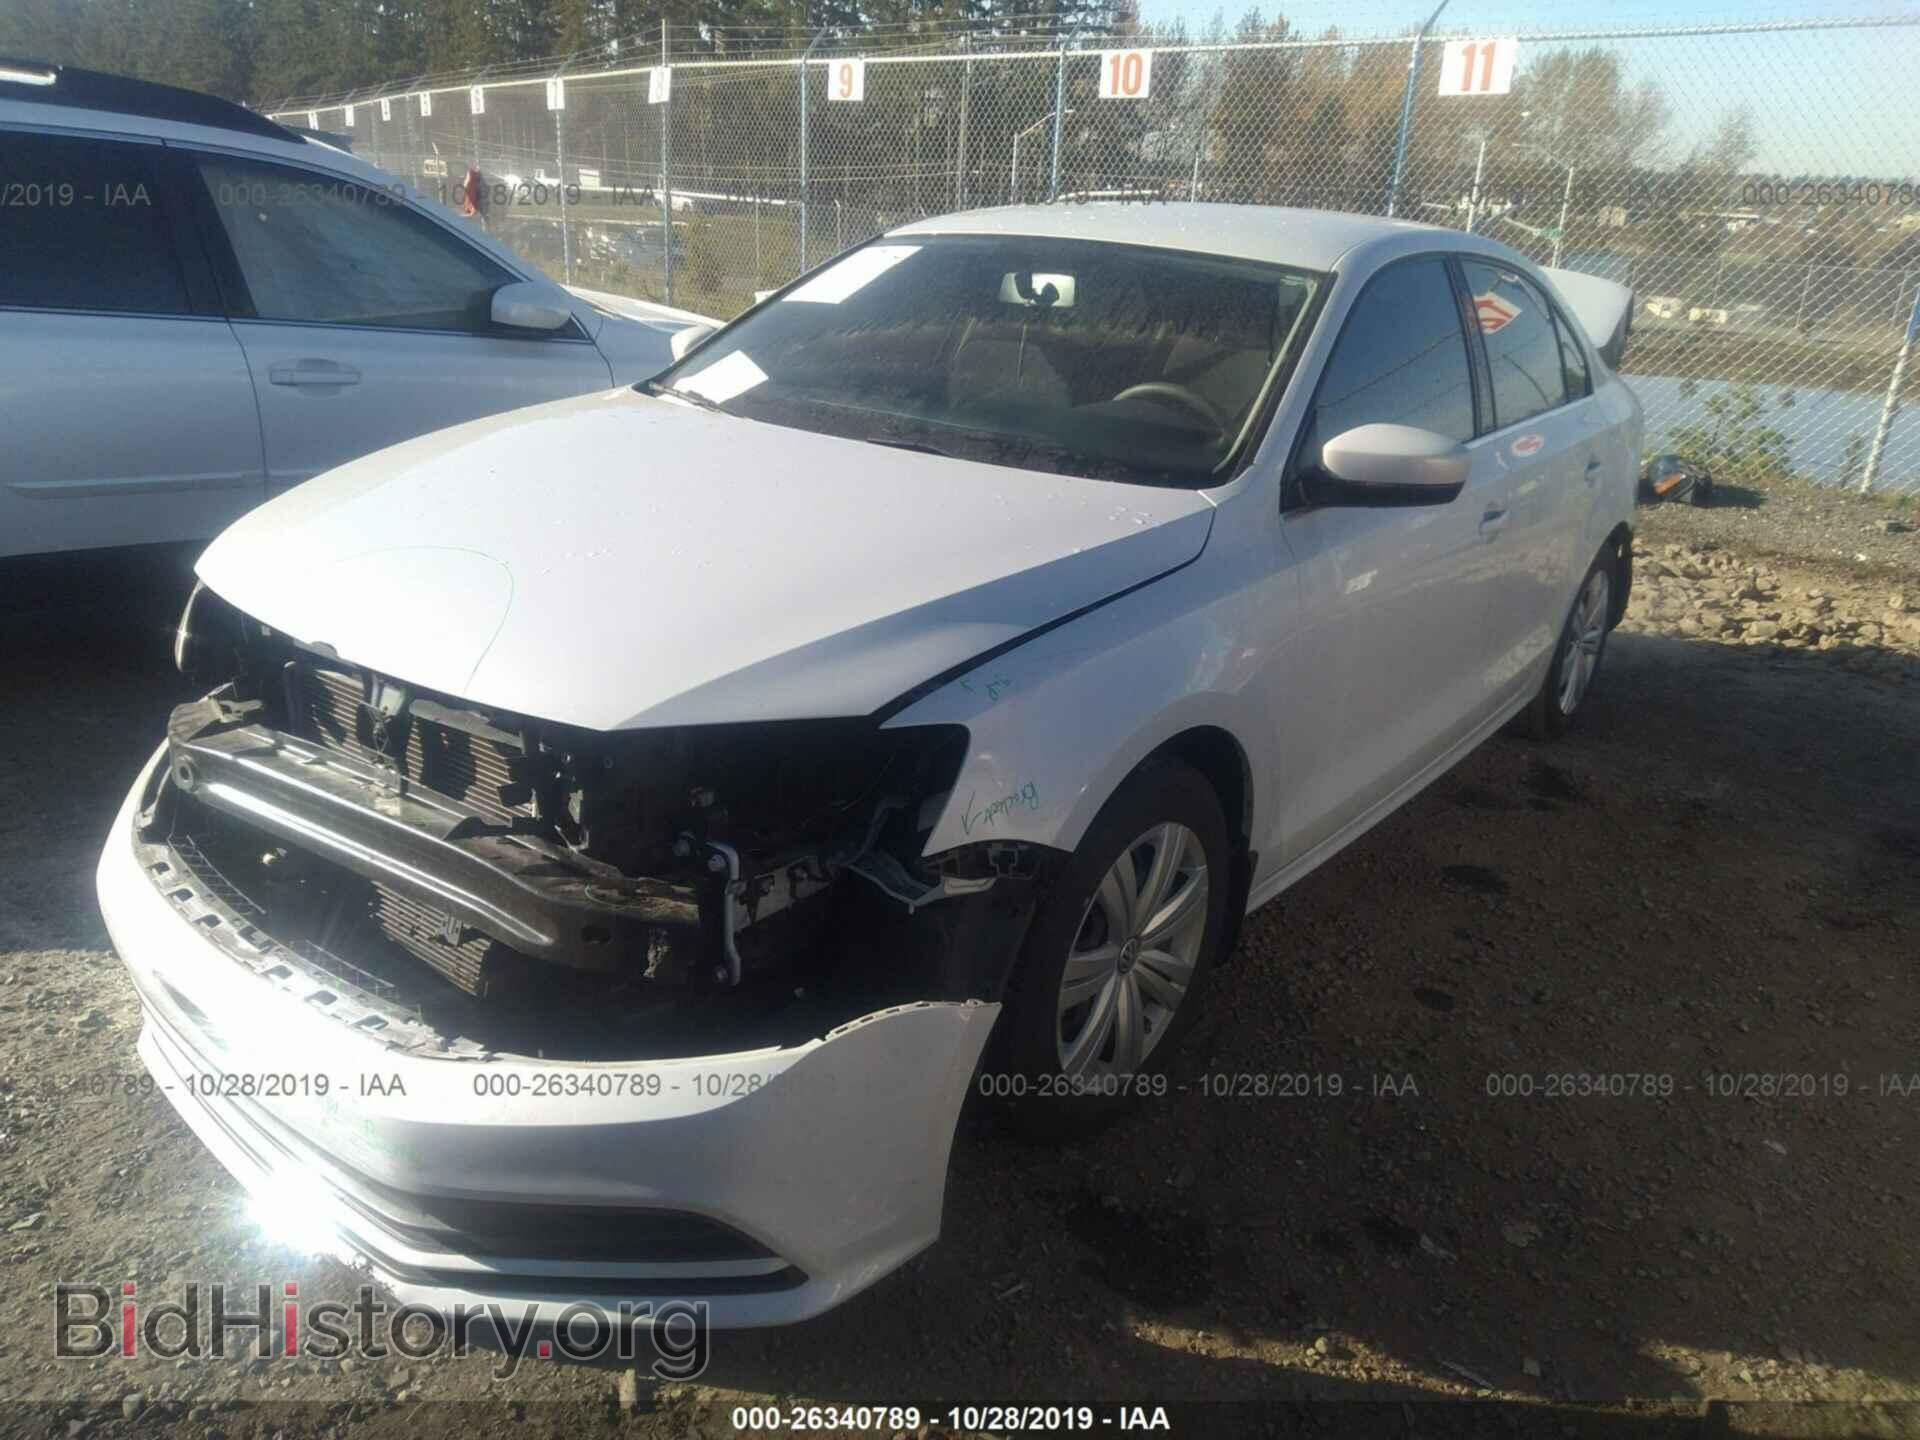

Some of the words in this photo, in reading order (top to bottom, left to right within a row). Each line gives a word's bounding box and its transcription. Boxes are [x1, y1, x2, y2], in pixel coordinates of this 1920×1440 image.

[840, 63, 853, 97] 9
[1110, 53, 1142, 95] 10
[1461, 43, 1496, 91] 11
